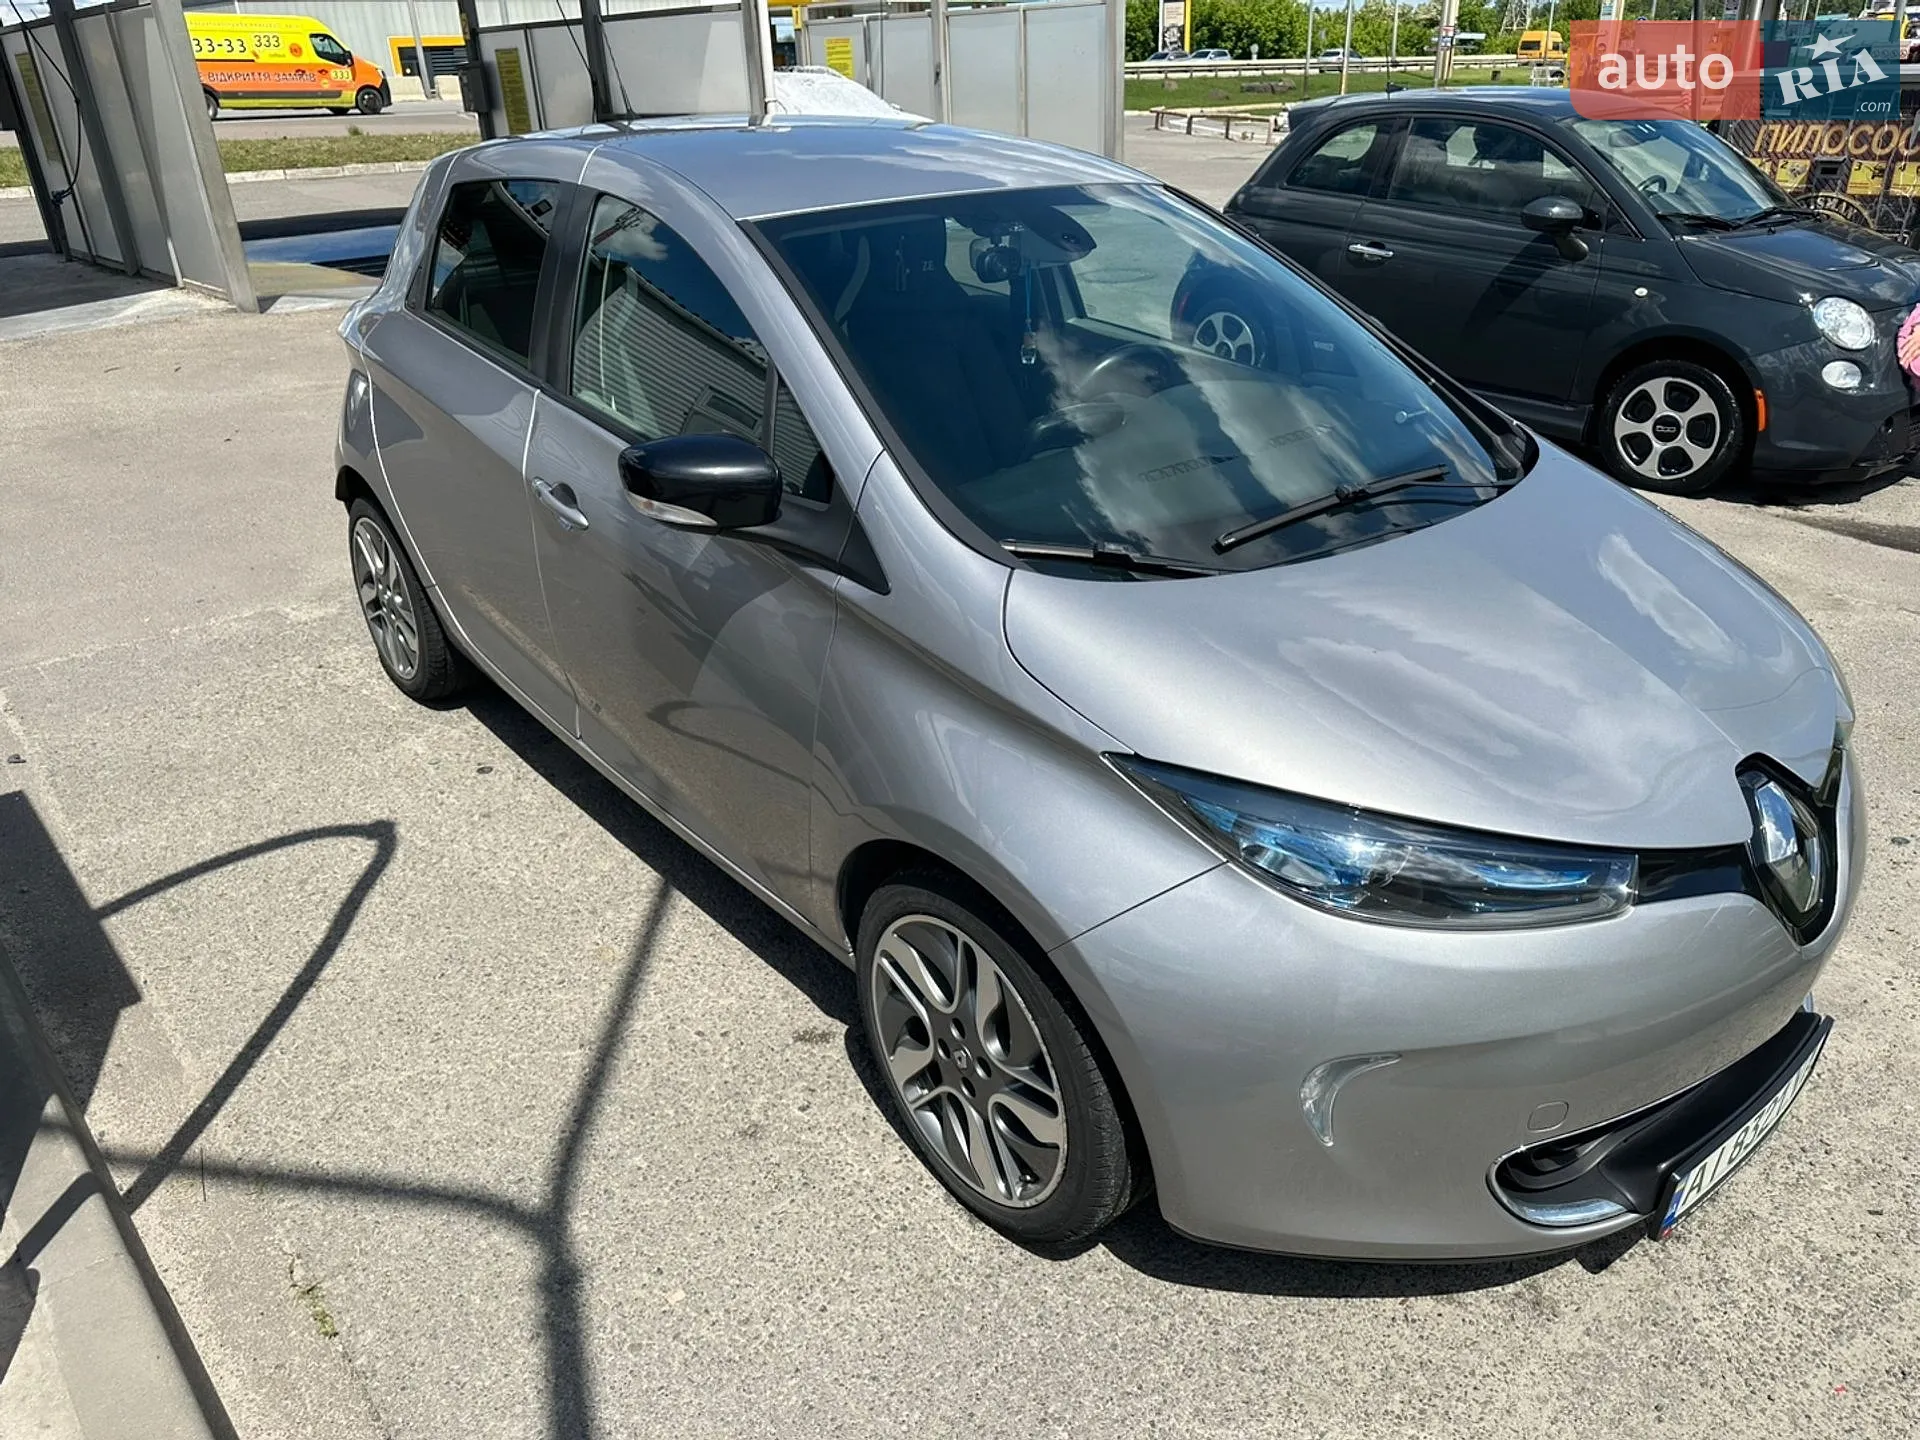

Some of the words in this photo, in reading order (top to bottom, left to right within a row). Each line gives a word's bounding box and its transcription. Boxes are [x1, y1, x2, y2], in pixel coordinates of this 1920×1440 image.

[253, 34, 281, 48] 333
[207, 71, 271, 83] ВІДКРИТТЯ
[333, 70, 350, 80] 333
